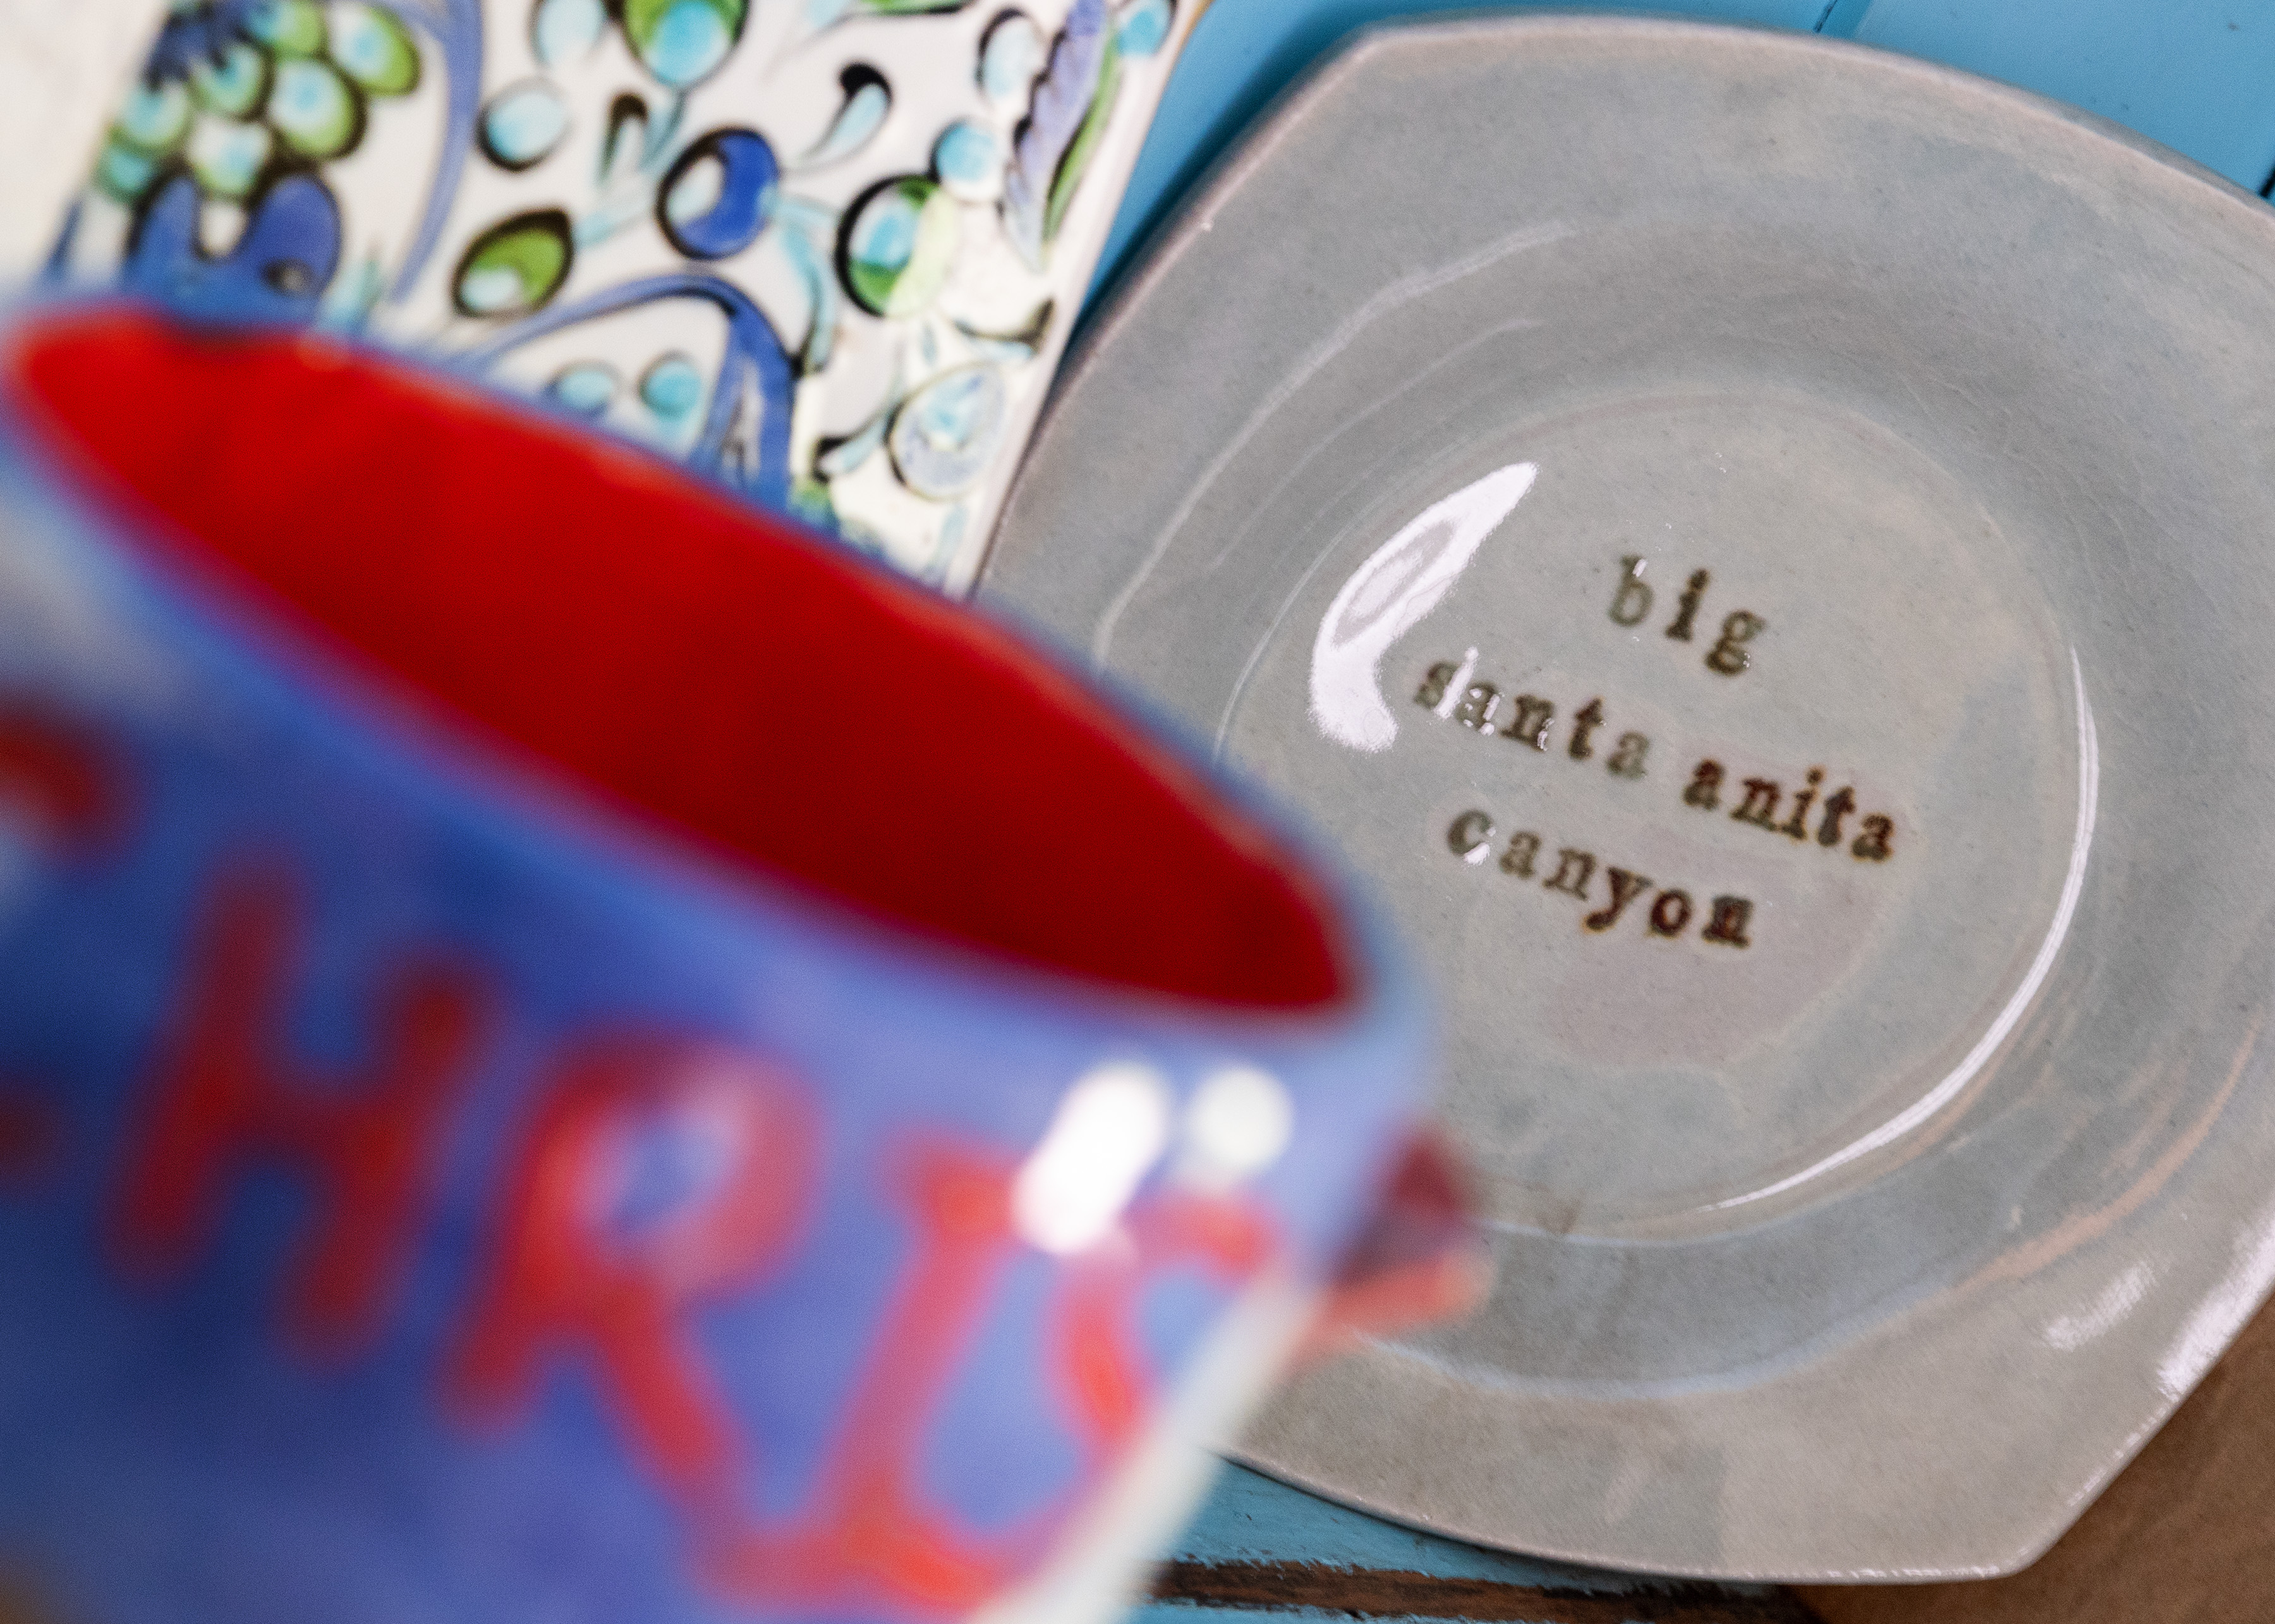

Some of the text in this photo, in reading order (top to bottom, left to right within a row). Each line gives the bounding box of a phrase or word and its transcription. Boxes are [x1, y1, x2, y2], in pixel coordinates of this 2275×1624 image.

[1606, 554, 1768, 676] big
[1412, 660, 1895, 863] santa anita
[1447, 809, 1756, 949] canyon
